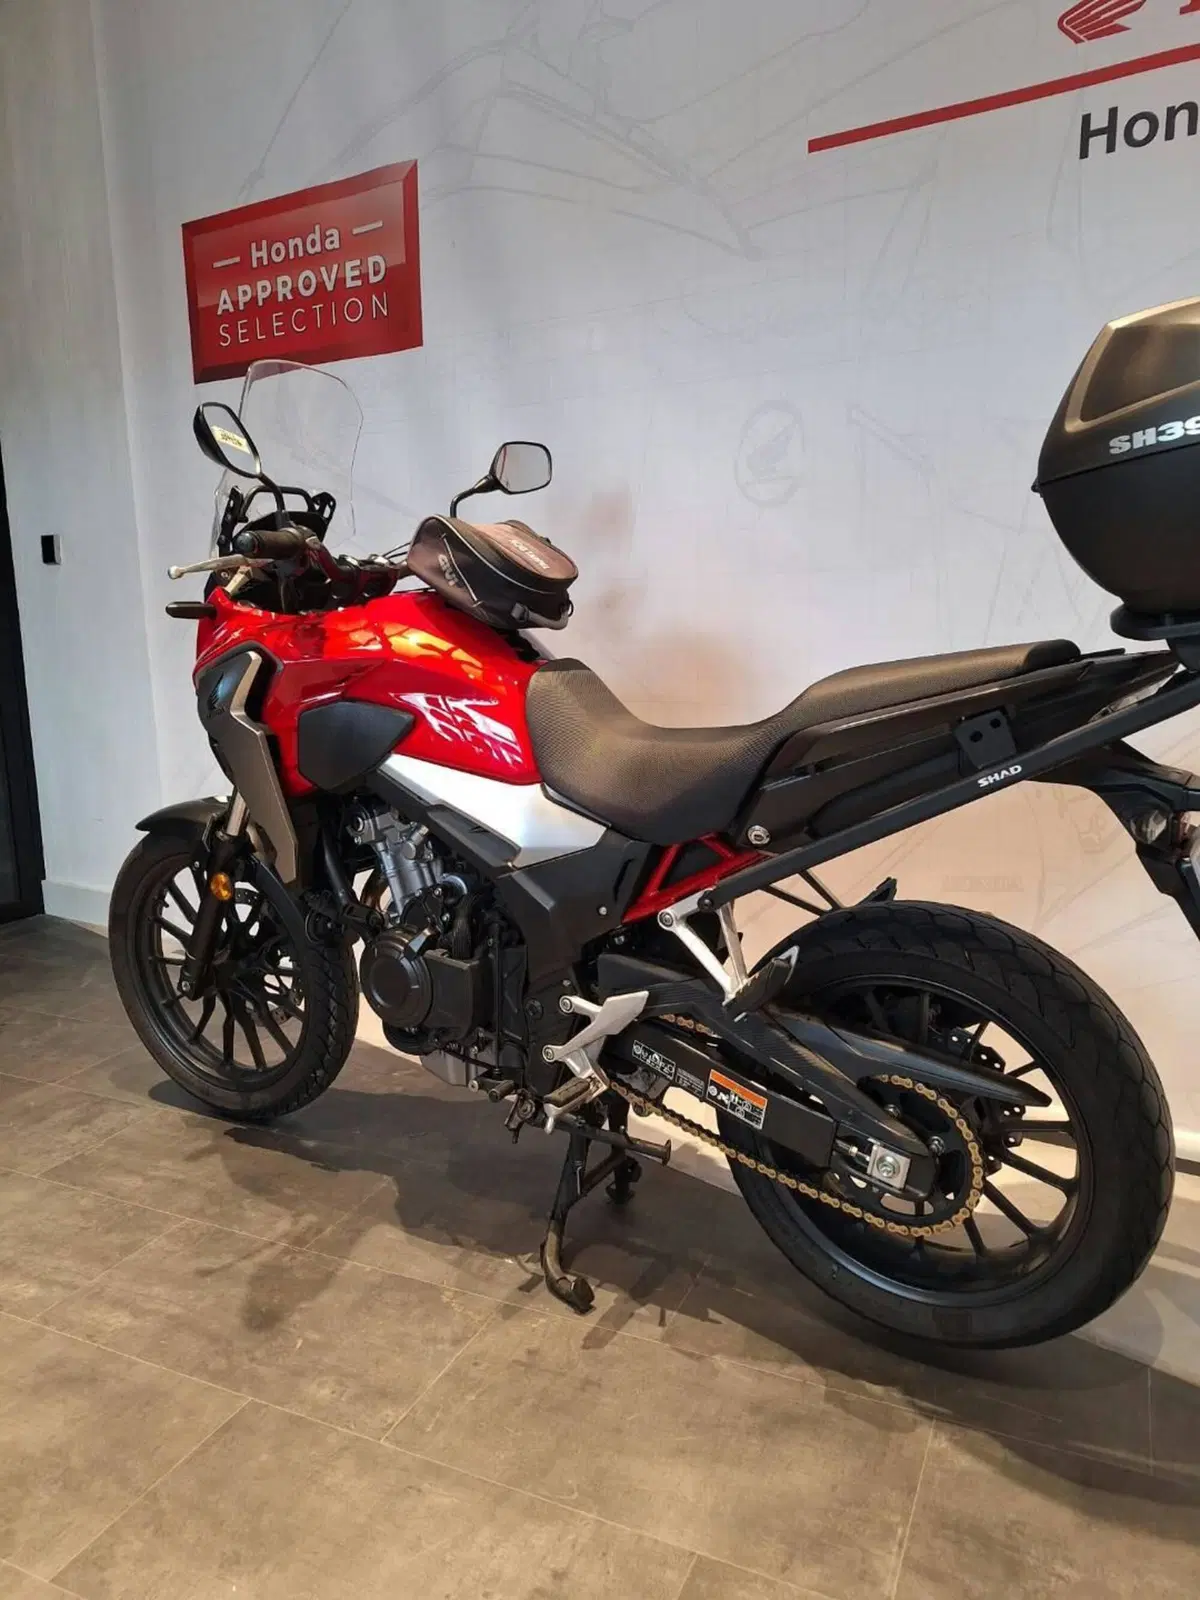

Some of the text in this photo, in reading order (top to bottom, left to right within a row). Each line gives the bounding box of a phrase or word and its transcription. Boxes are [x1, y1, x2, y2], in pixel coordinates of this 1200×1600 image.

[1079, 100, 1200, 160] Hon
[251, 224, 340, 268] Honda
[216, 255, 387, 316] APPROVED
[218, 291, 389, 347] SELECTION
[977, 764, 1023, 788] SHAD
